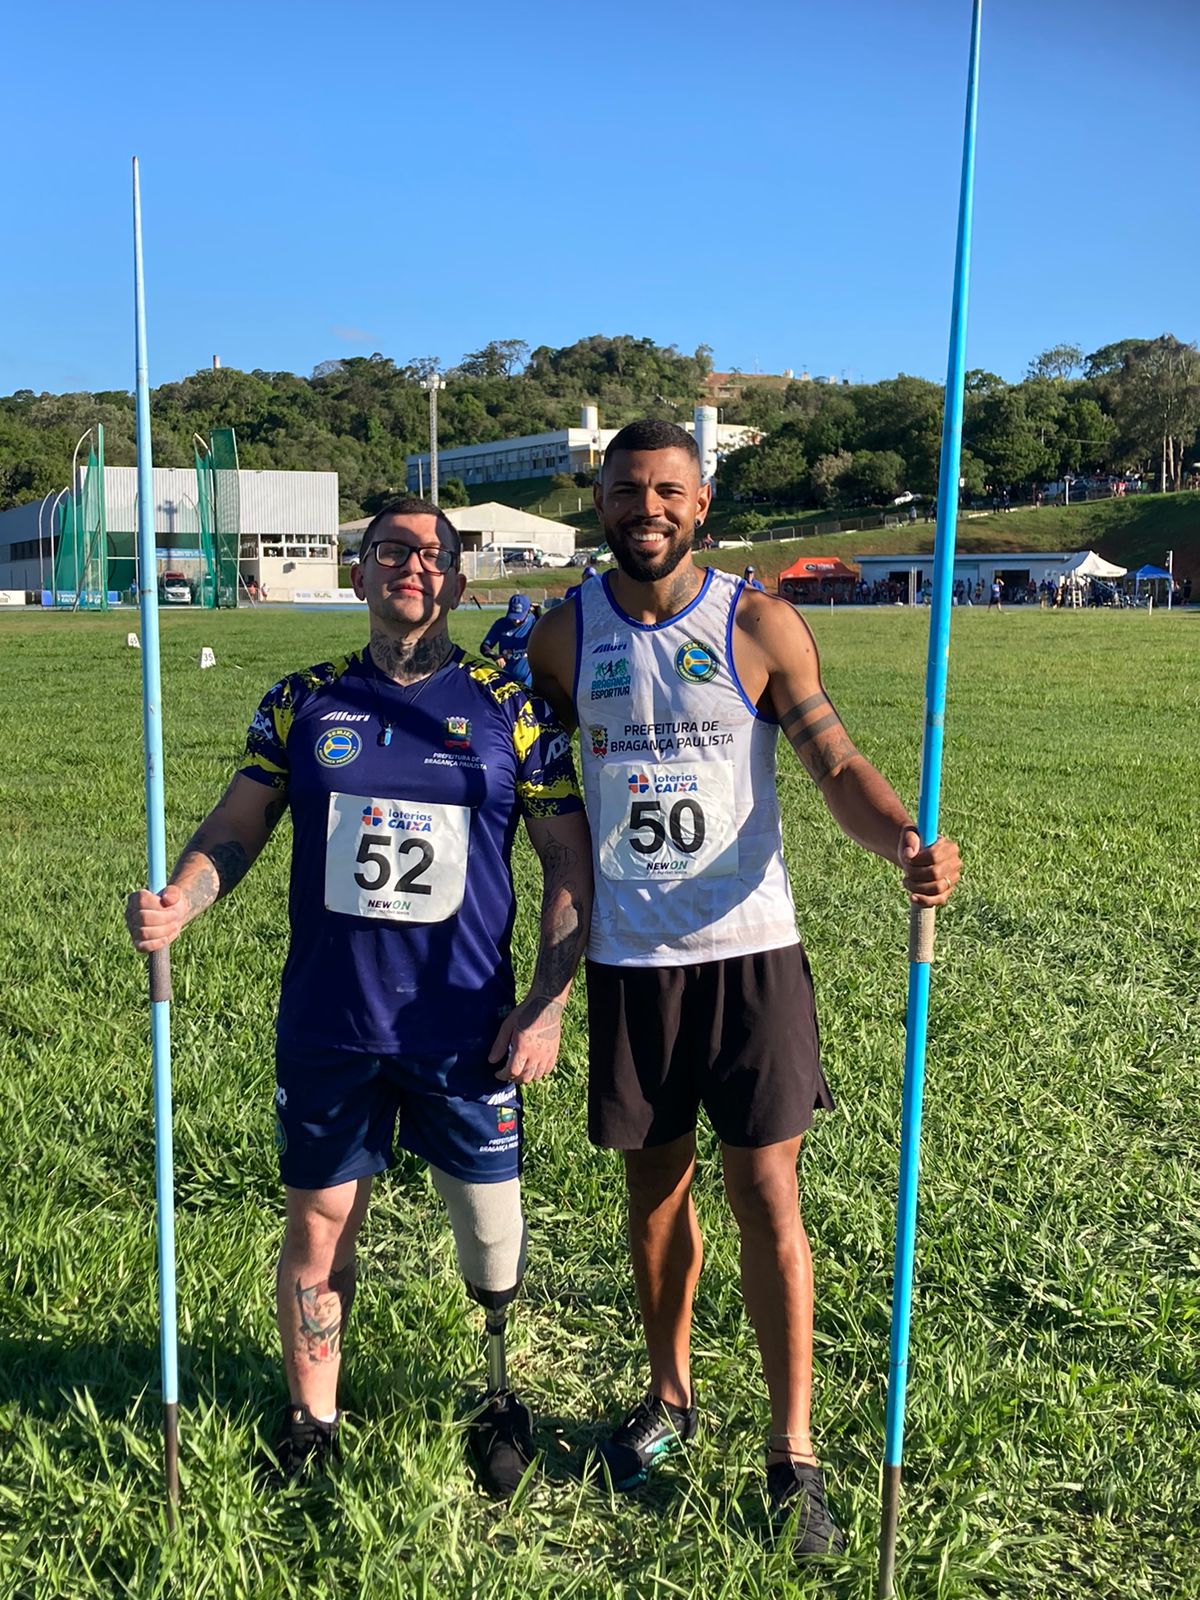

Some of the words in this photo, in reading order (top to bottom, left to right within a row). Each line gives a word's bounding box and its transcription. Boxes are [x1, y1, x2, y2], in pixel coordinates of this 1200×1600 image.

[203, 652, 214, 662] 35
[591, 686, 631, 701] ESPORTIVA
[624, 722, 698, 736] PREFEITURA
[701, 721, 719, 732] DE
[610, 739, 674, 753] BRAGANÇA
[676, 733, 735, 749] PAULISTA
[433, 752, 471, 761] PREFEITURA
[424, 758, 459, 767] BRAGANÇA
[459, 761, 488, 770] PAULISTA
[654, 774, 698, 783] loterias
[655, 782, 698, 793] CAIXA
[388, 808, 433, 821] loterias
[388, 819, 432, 832] CAIXA
[629, 799, 706, 854] 50
[354, 833, 435, 895] 52
